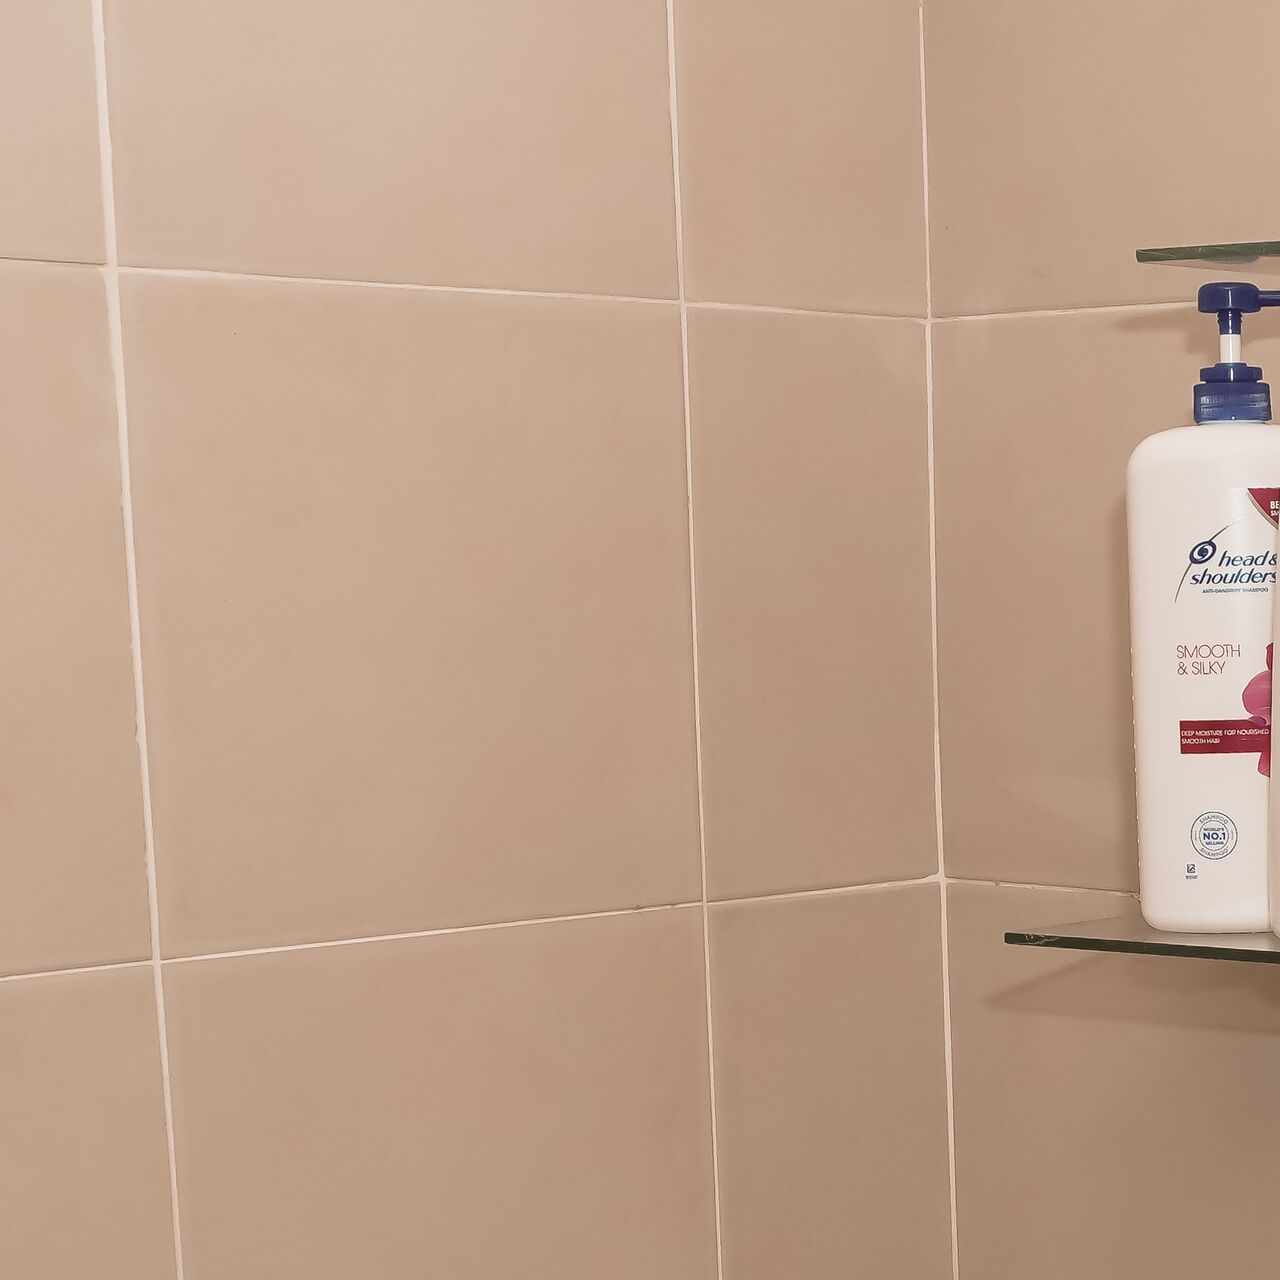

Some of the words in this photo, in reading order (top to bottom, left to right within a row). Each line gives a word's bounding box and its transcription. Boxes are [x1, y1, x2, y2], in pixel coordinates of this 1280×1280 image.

[1218, 550, 1269, 567] head
[1190, 568, 1276, 585] shoulders
[1176, 644, 1241, 659] SMOOTH
[1177, 661, 1188, 675] &
[1191, 661, 1226, 675] SILKY
[1203, 832, 1226, 840] NO.1
